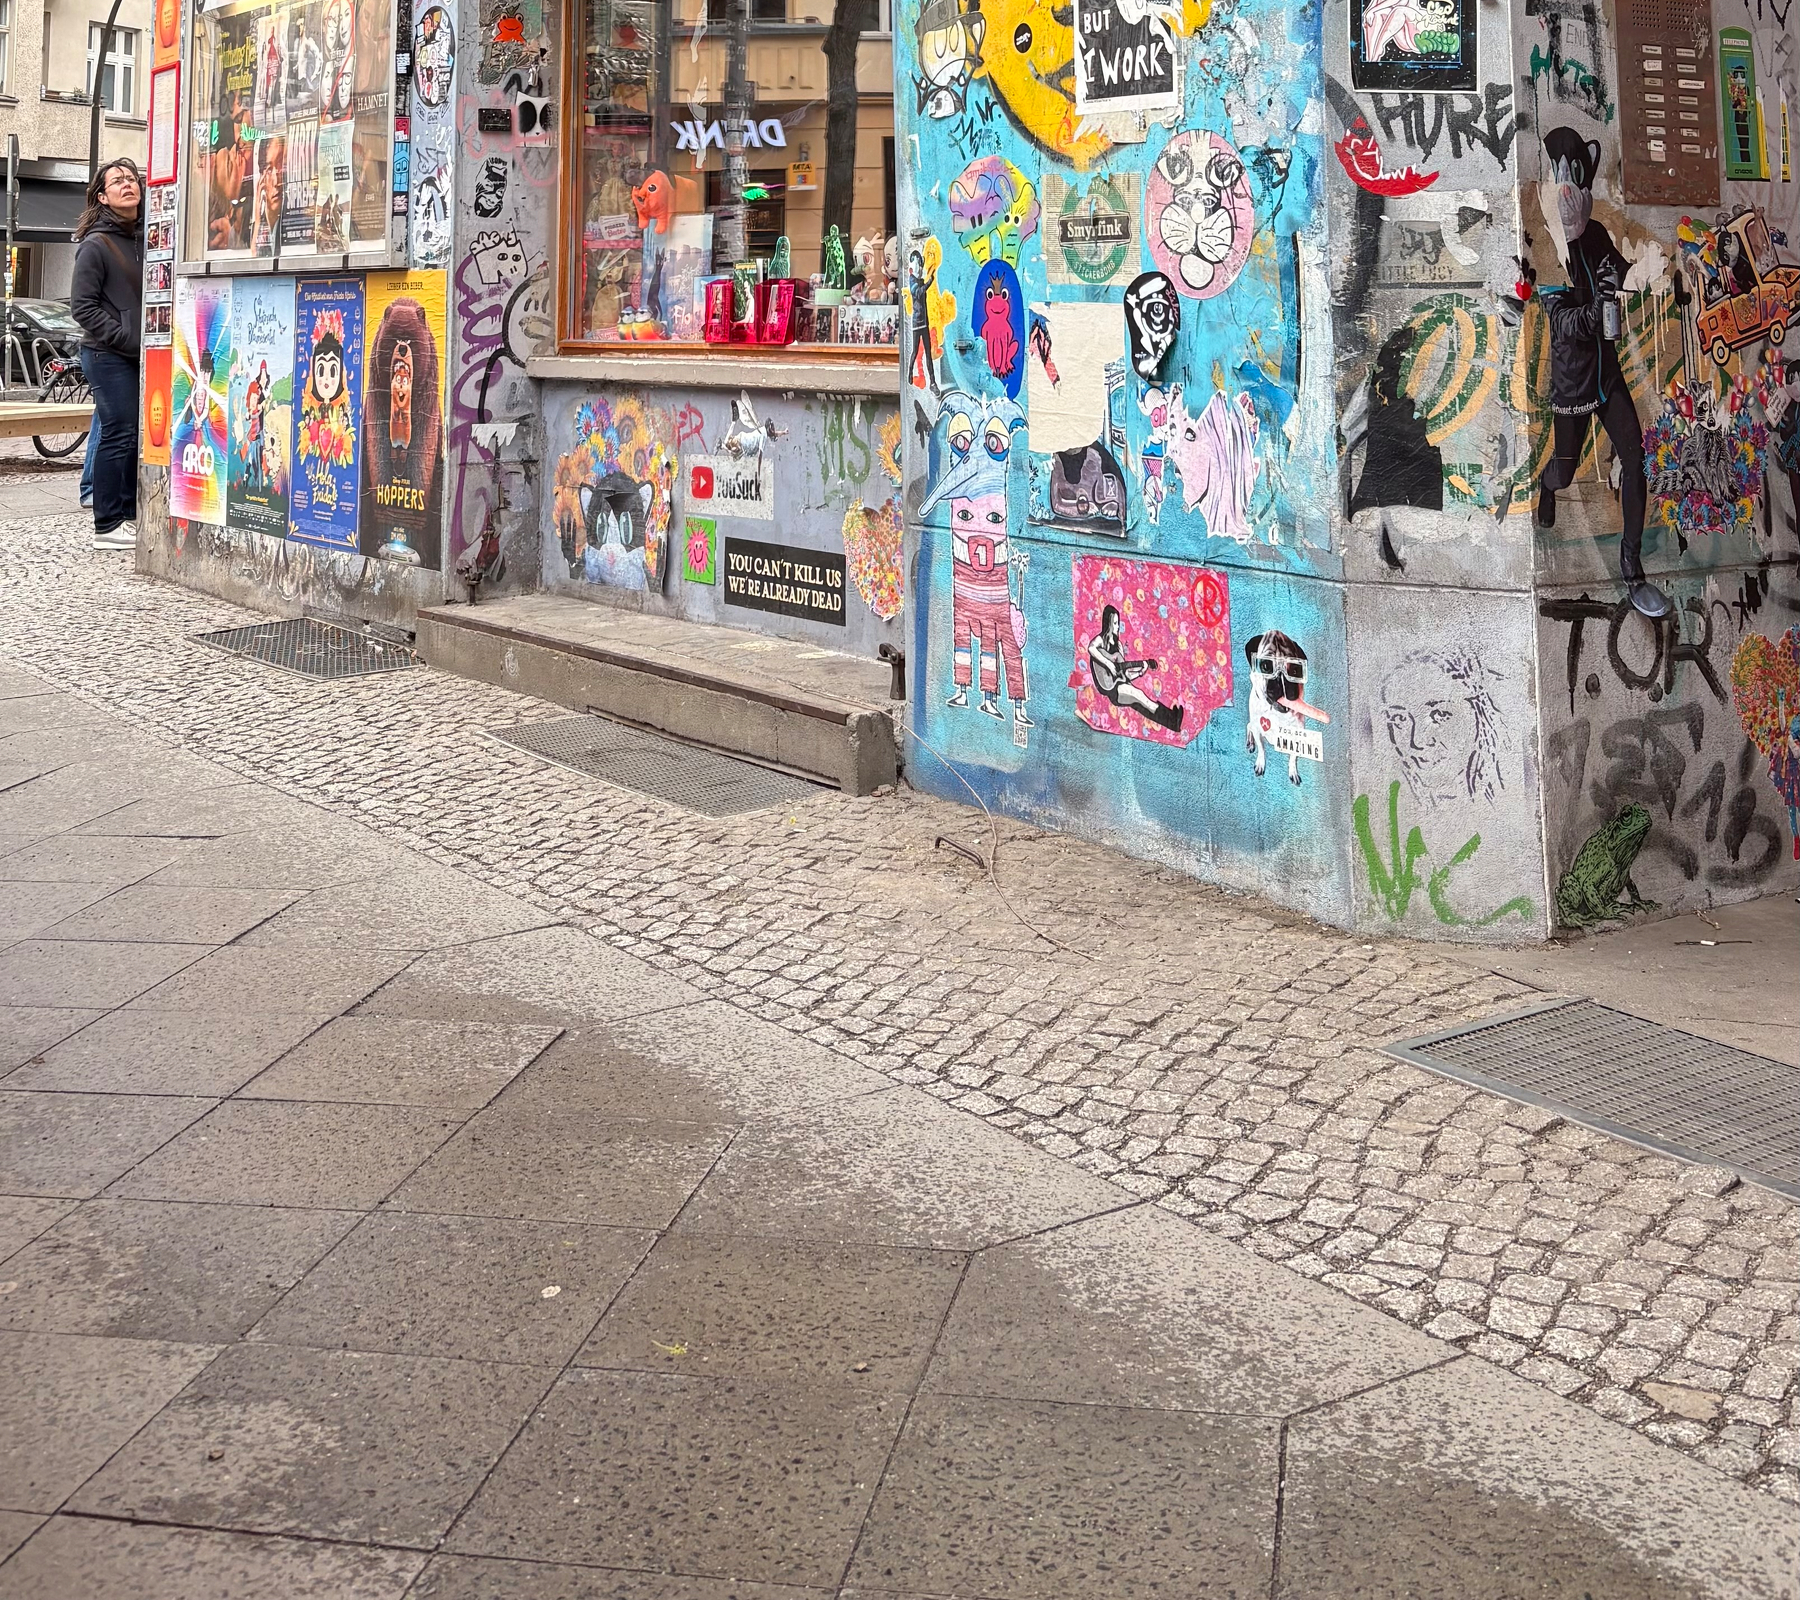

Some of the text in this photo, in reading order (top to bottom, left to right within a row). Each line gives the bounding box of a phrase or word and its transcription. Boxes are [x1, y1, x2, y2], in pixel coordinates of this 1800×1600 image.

[1083, 11, 1112, 34] BUT
[1082, 40, 1166, 86] I WORK
[357, 93, 388, 112] HAMNET
[182, 443, 215, 476] ARCO
[377, 484, 425, 511] HOPPERS
[728, 552, 842, 588] YOU CAN'T KILL US
[727, 575, 842, 612] WE'RE ALREADY DEAD
[1277, 737, 1319, 759] AMAZING
